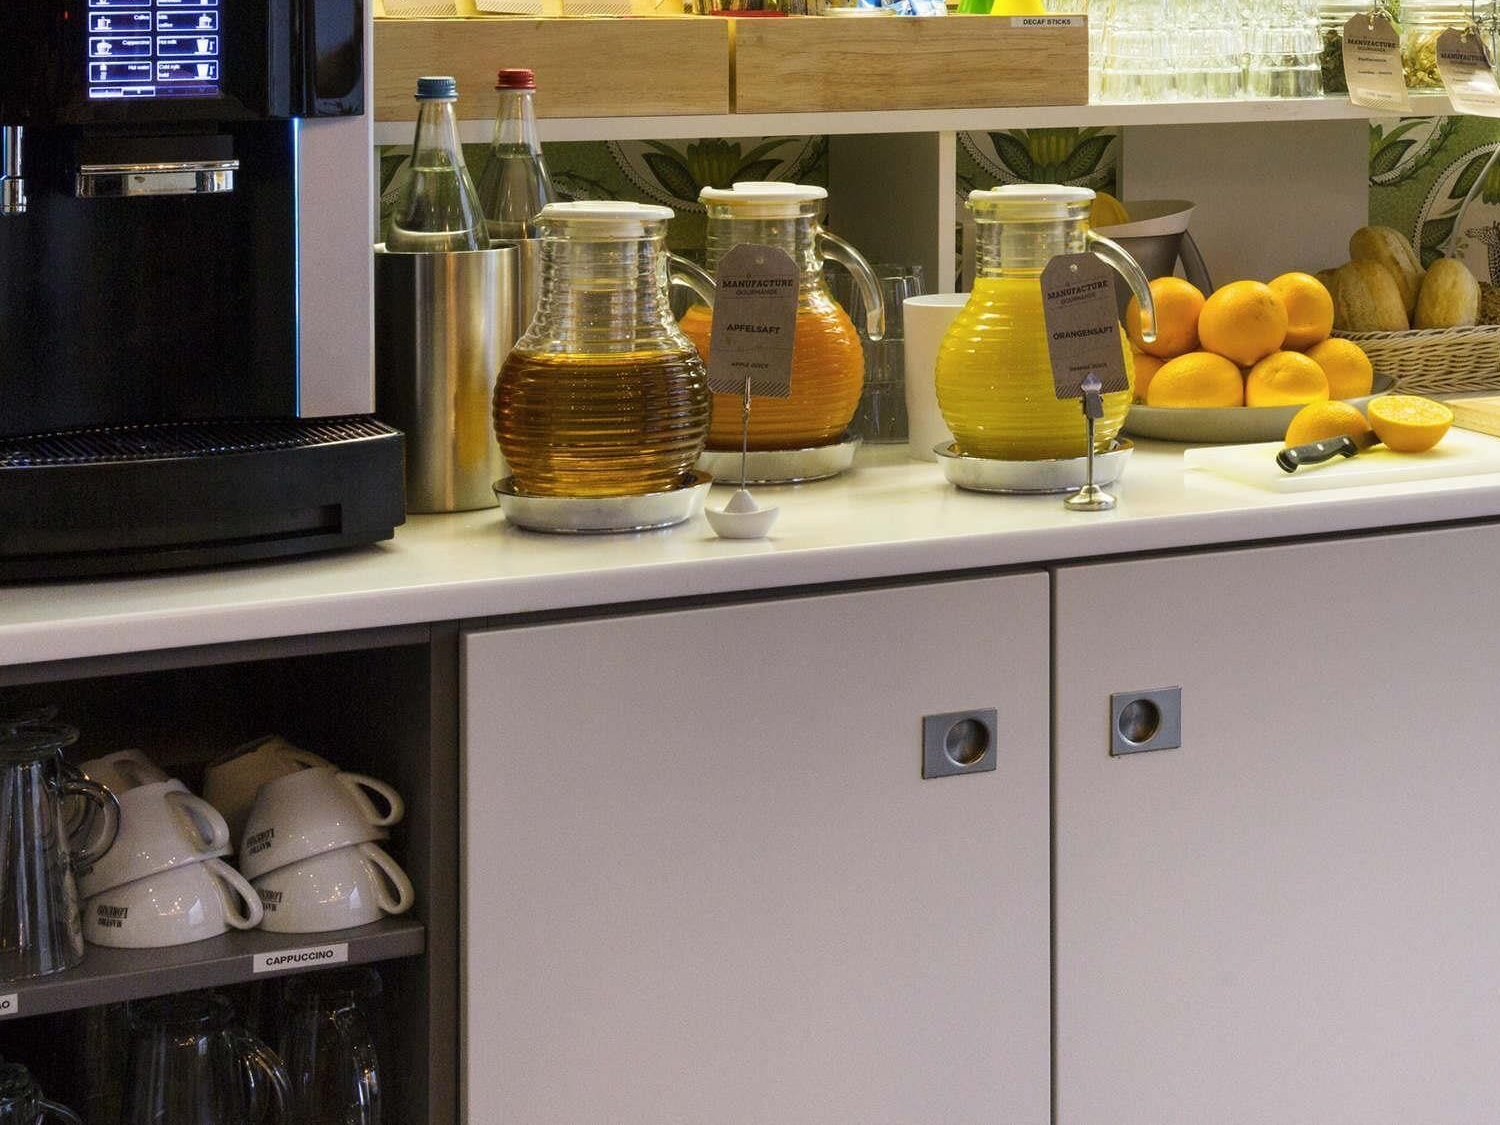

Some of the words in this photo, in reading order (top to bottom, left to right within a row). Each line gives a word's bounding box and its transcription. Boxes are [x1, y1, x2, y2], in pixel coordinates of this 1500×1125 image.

[1023, 18, 1044, 26] DECAF
[1046, 18, 1072, 26] STICKS
[722, 279, 794, 289] MANUFACTURE
[1047, 280, 1109, 300] MANUFACTURE
[726, 324, 781, 335] APFELSAFT
[1052, 326, 1114, 340] ORANGENSAFT
[265, 950, 334, 966] CAPPUCCINO
